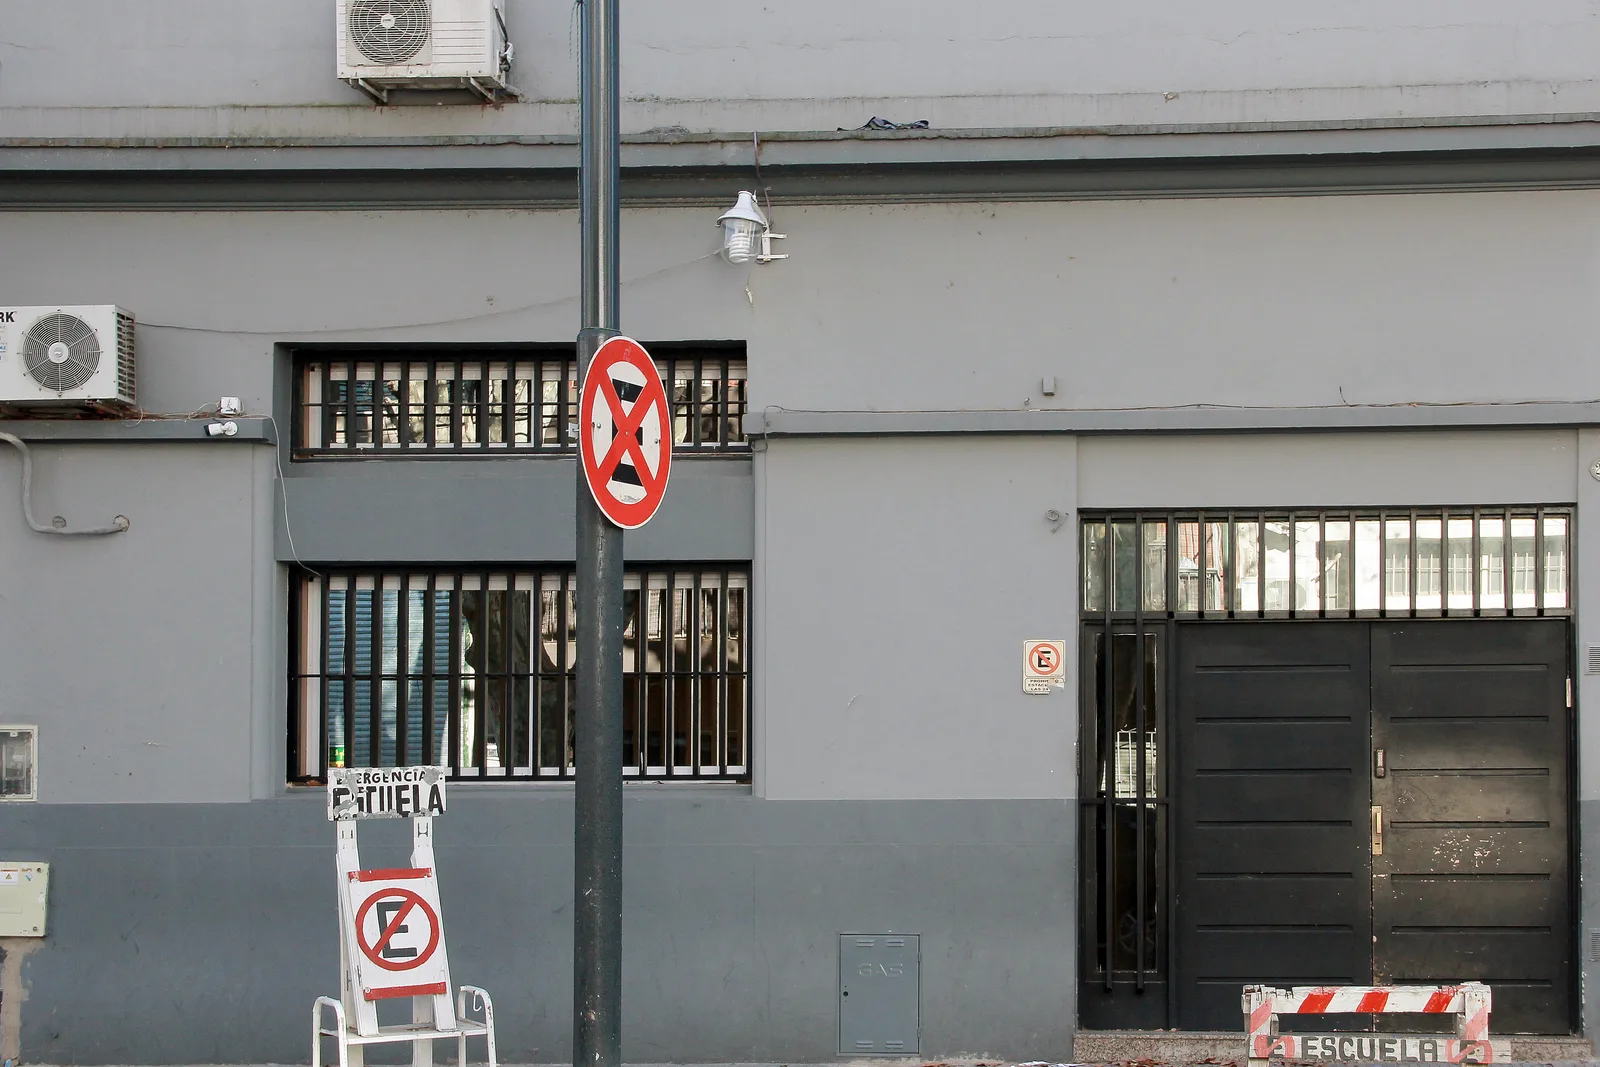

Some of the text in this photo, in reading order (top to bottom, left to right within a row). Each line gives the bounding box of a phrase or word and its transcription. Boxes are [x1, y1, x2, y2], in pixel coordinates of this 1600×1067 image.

[1038, 651, 1051, 667] E
[337, 771, 426, 785] EERGENCIA
[377, 901, 418, 958] E
[858, 963, 903, 978] GAS
[1301, 1036, 1438, 1062] ESCUELA
